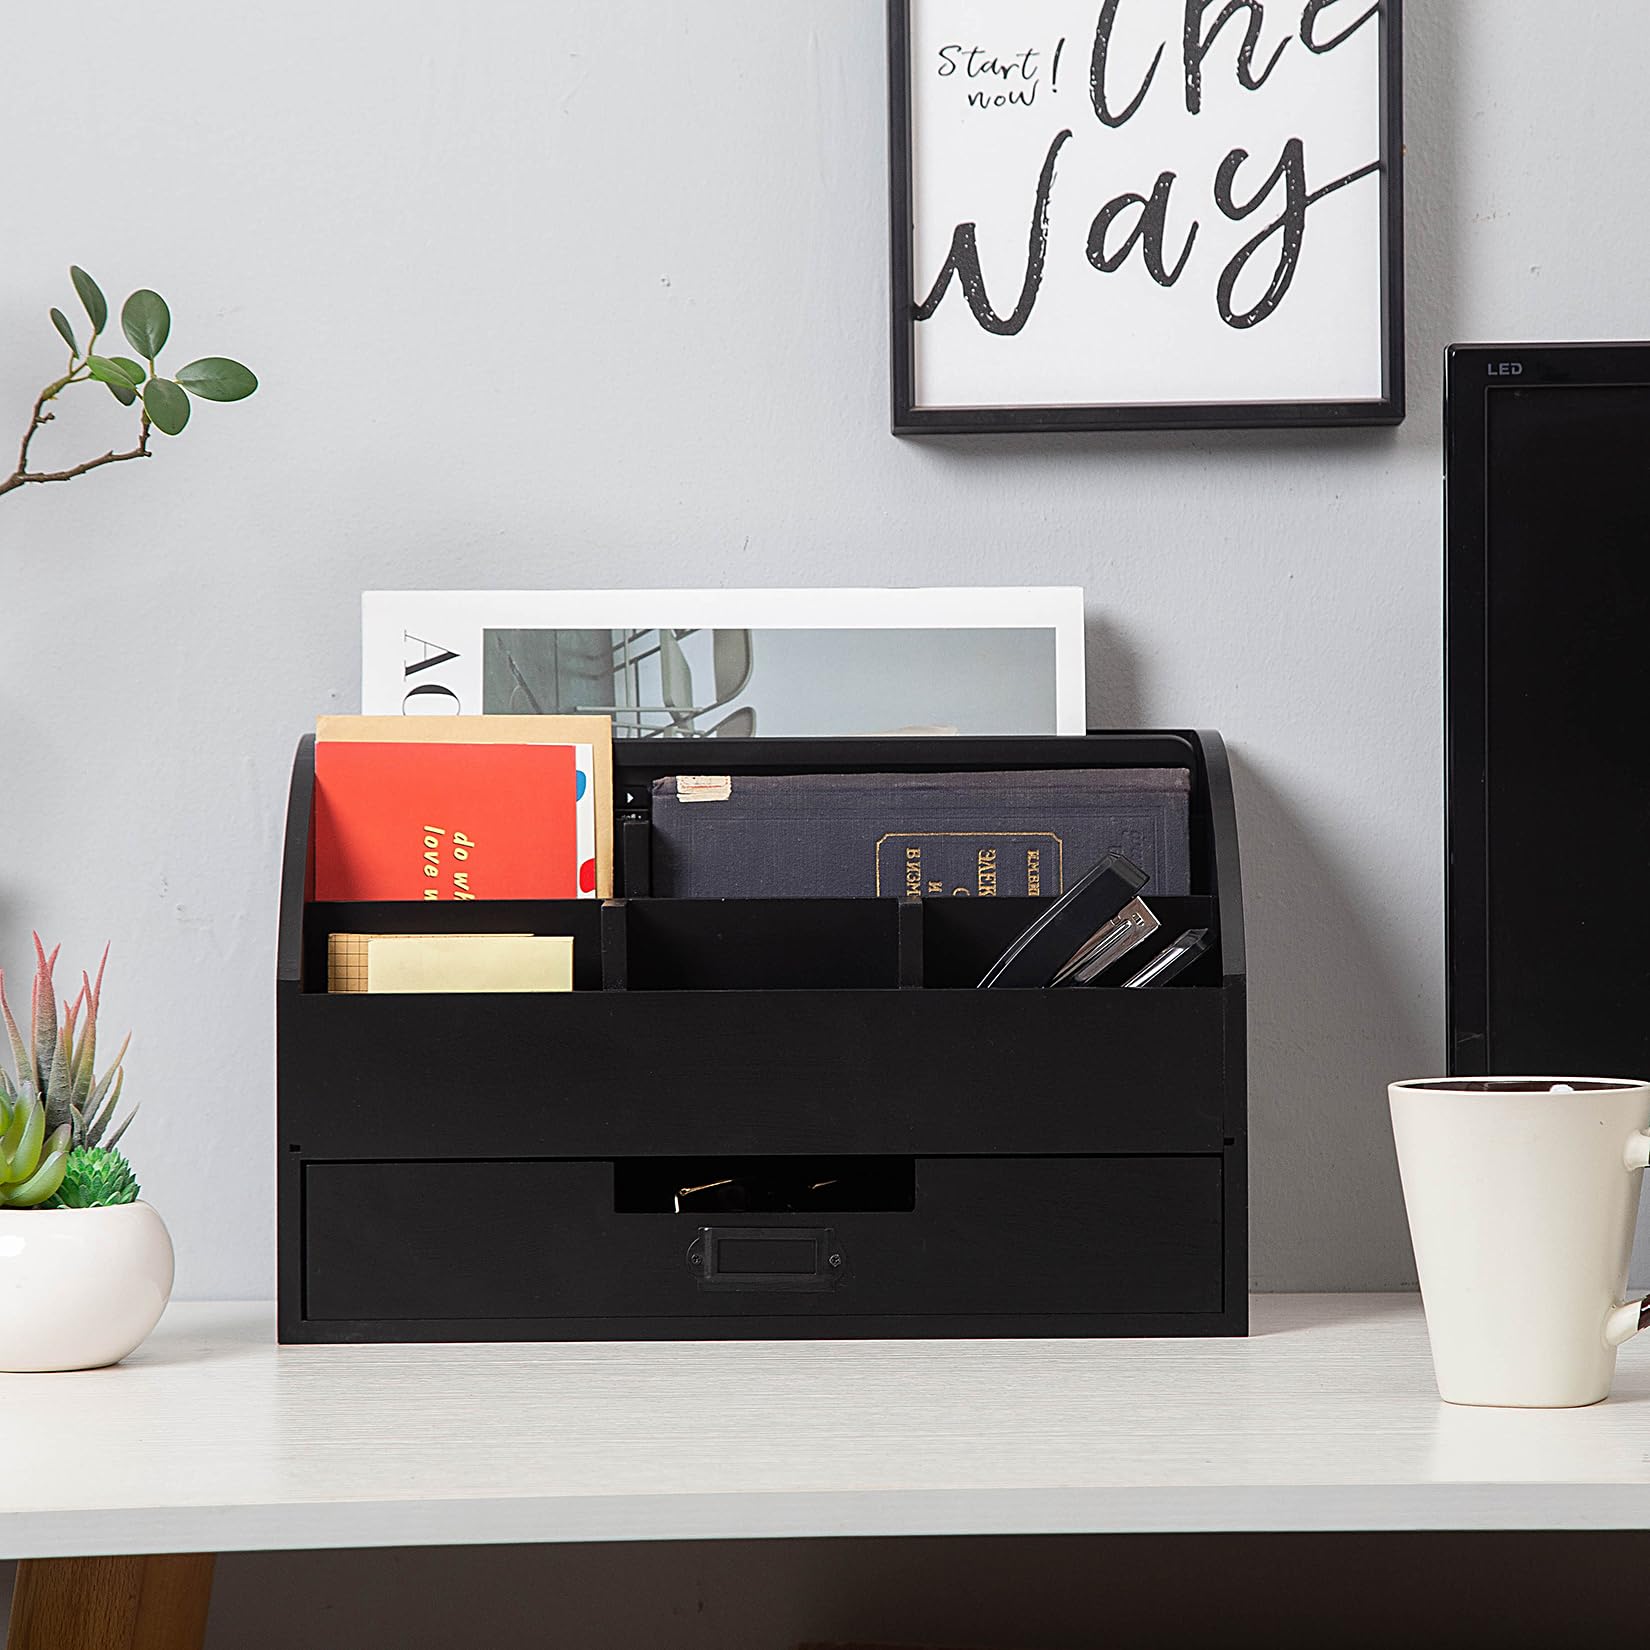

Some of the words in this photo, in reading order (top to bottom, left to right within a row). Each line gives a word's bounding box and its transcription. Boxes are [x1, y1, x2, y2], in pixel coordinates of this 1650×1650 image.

[938, 45, 1040, 80] Start
[968, 79, 1040, 109] now
[1487, 353, 1523, 376] LED
[423, 825, 446, 878] love
[453, 831, 475, 862] do
